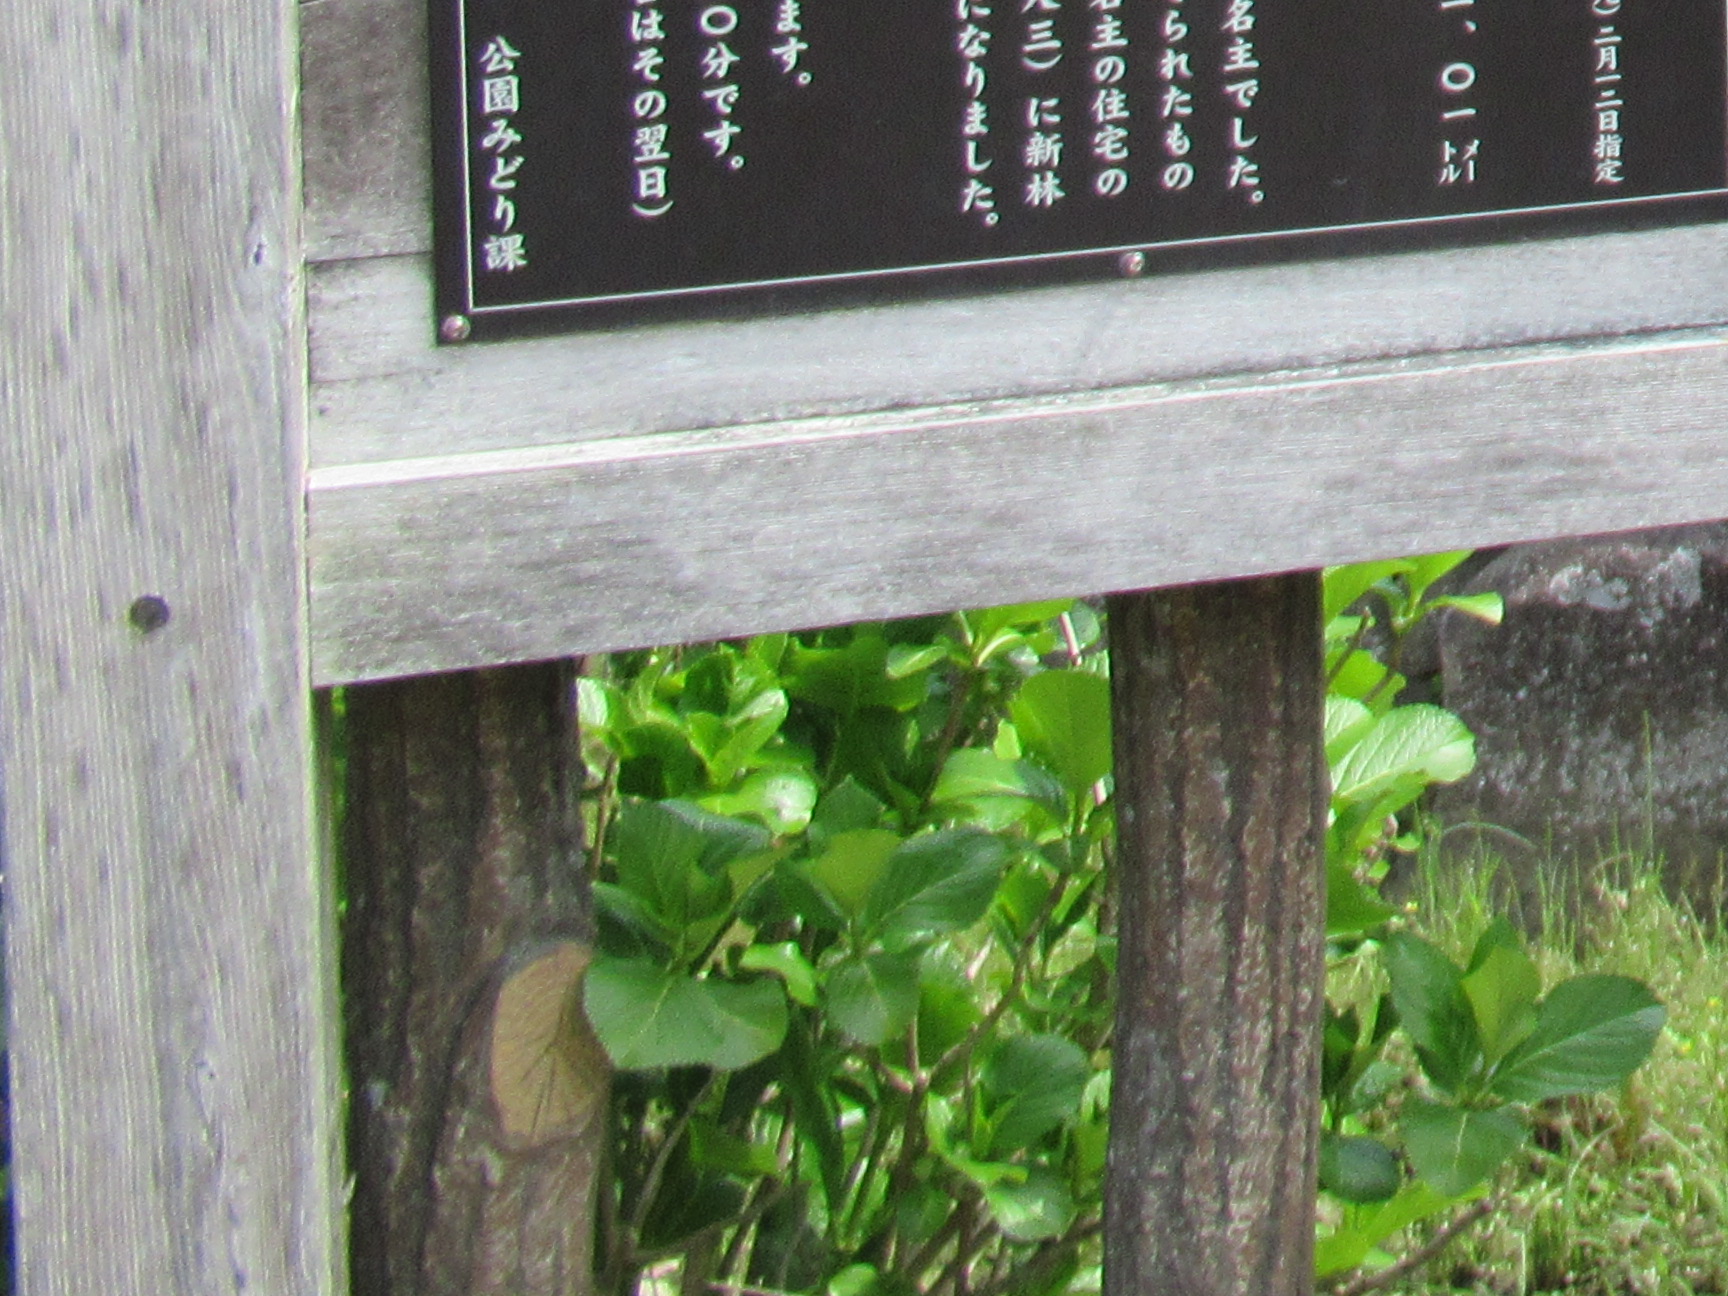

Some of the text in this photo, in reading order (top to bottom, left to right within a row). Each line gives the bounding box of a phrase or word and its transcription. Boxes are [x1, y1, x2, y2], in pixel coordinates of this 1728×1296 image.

[480, 36, 527, 272] 公園みどり課
